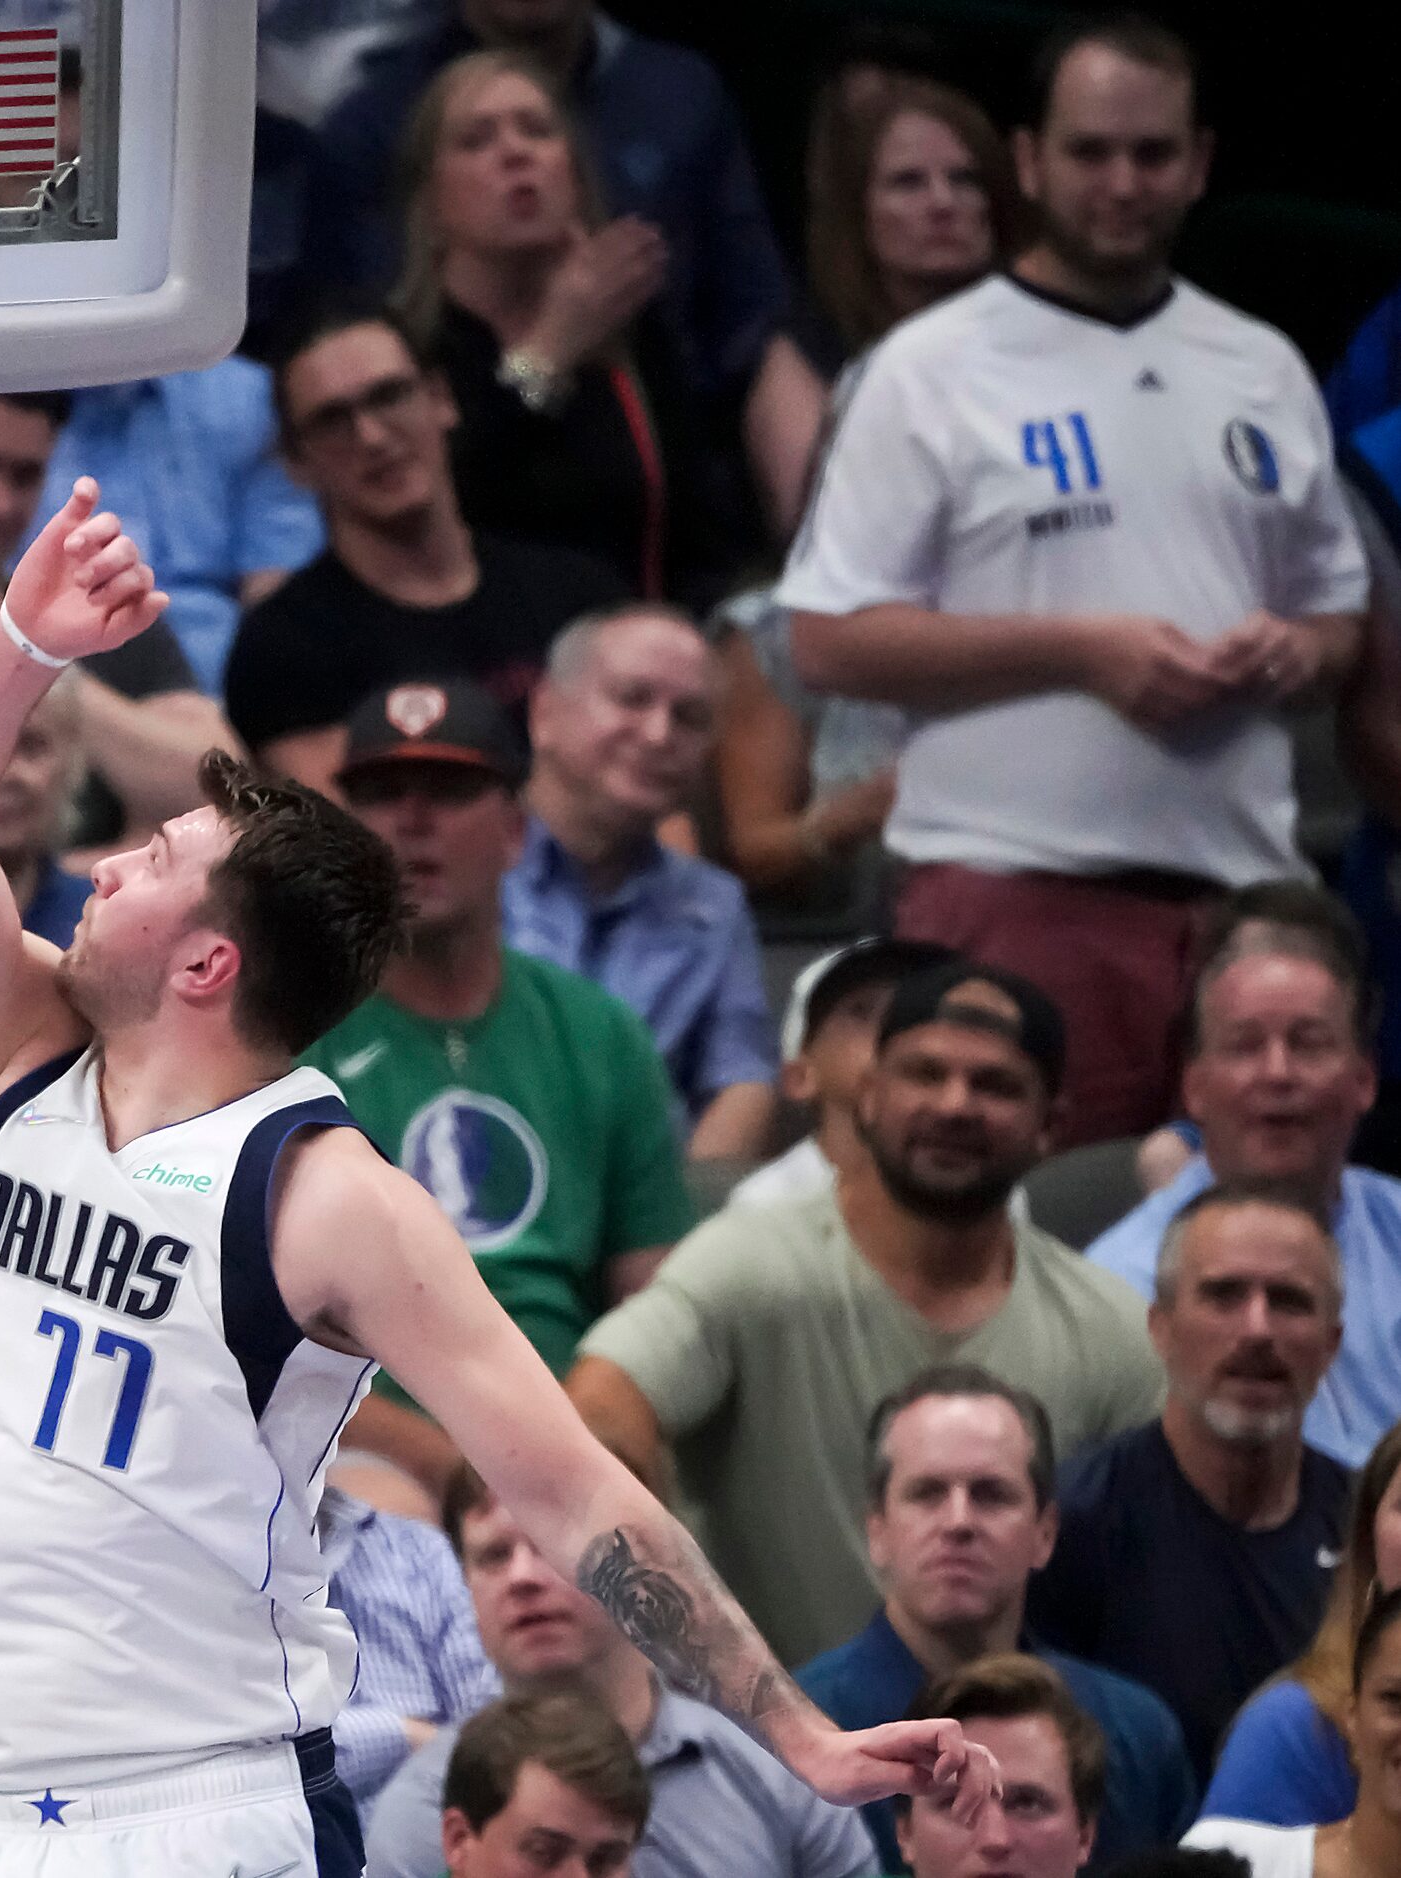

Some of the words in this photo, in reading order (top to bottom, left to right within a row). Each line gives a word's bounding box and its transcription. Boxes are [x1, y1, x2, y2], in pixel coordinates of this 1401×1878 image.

[1021, 411, 1102, 493] 41
[132, 1163, 212, 1193] chime
[32, 1306, 155, 1473] 77
